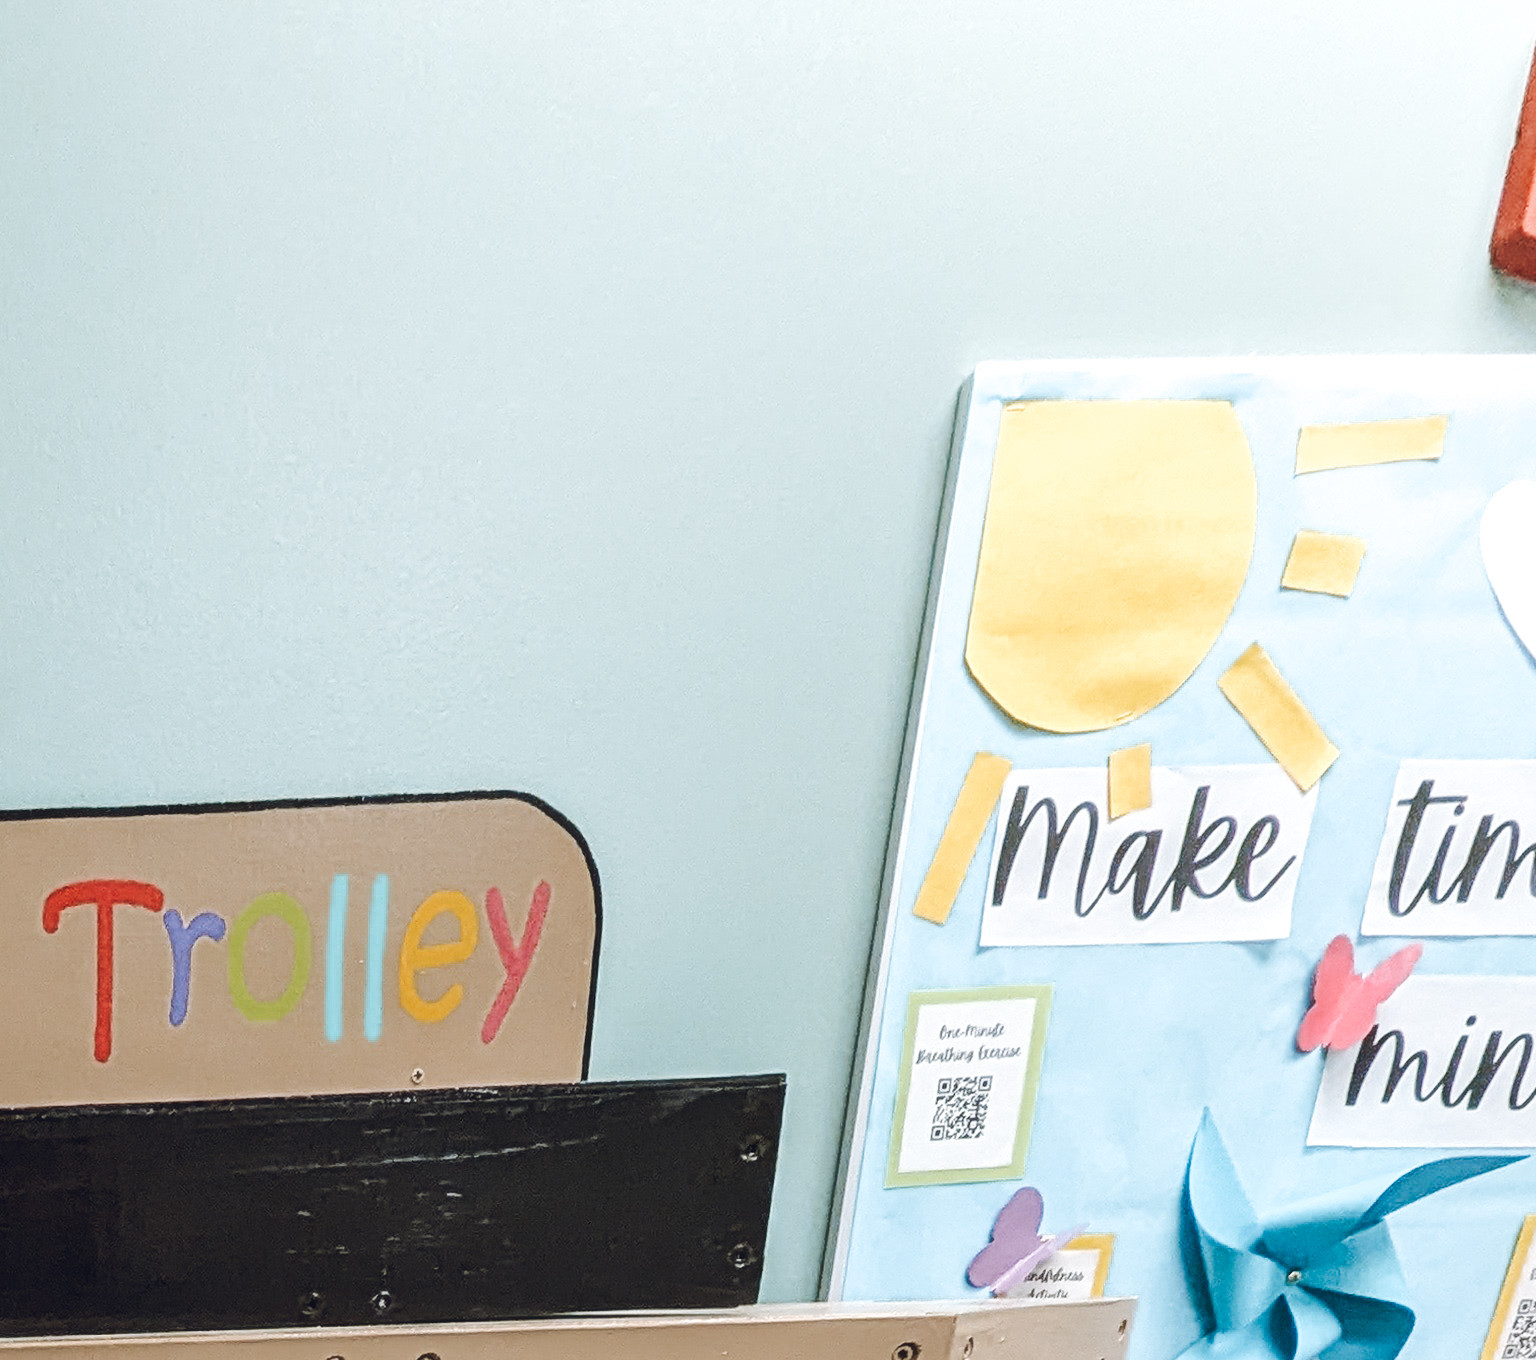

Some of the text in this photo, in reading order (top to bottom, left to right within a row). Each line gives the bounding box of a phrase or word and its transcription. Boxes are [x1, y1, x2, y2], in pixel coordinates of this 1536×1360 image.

[992, 785, 1296, 921] Make
[41, 872, 552, 1063] Trolley
[915, 1045, 1021, 1064] Breathing Exercise
[1345, 1014, 1536, 1111] min
